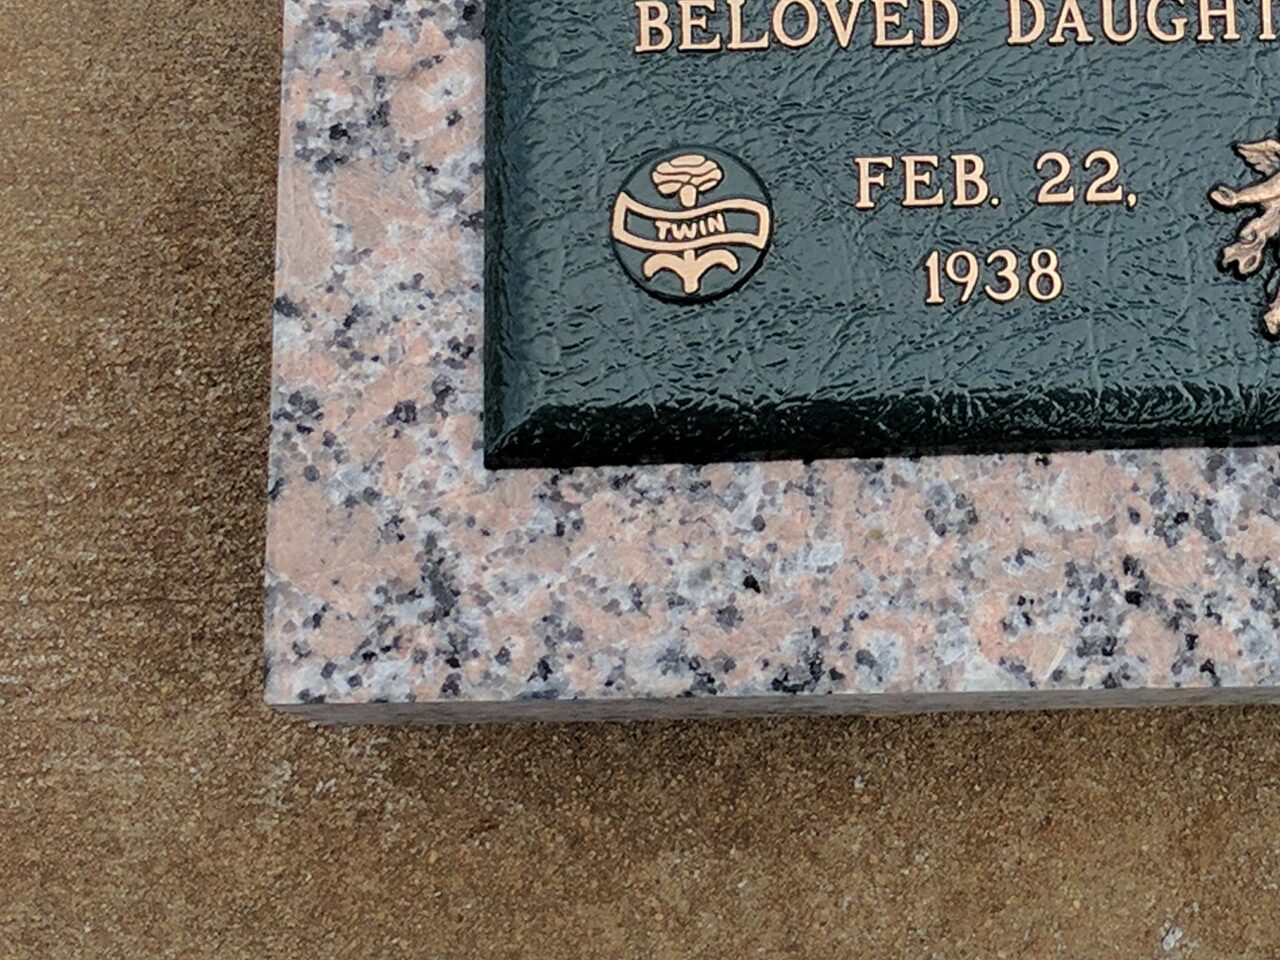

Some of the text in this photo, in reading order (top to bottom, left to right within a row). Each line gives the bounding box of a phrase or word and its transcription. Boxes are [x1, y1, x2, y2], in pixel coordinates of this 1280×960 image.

[855, 150, 1137, 208] FEB. 22,
[654, 213, 726, 240] TWIN
[927, 249, 1062, 303] 1938
